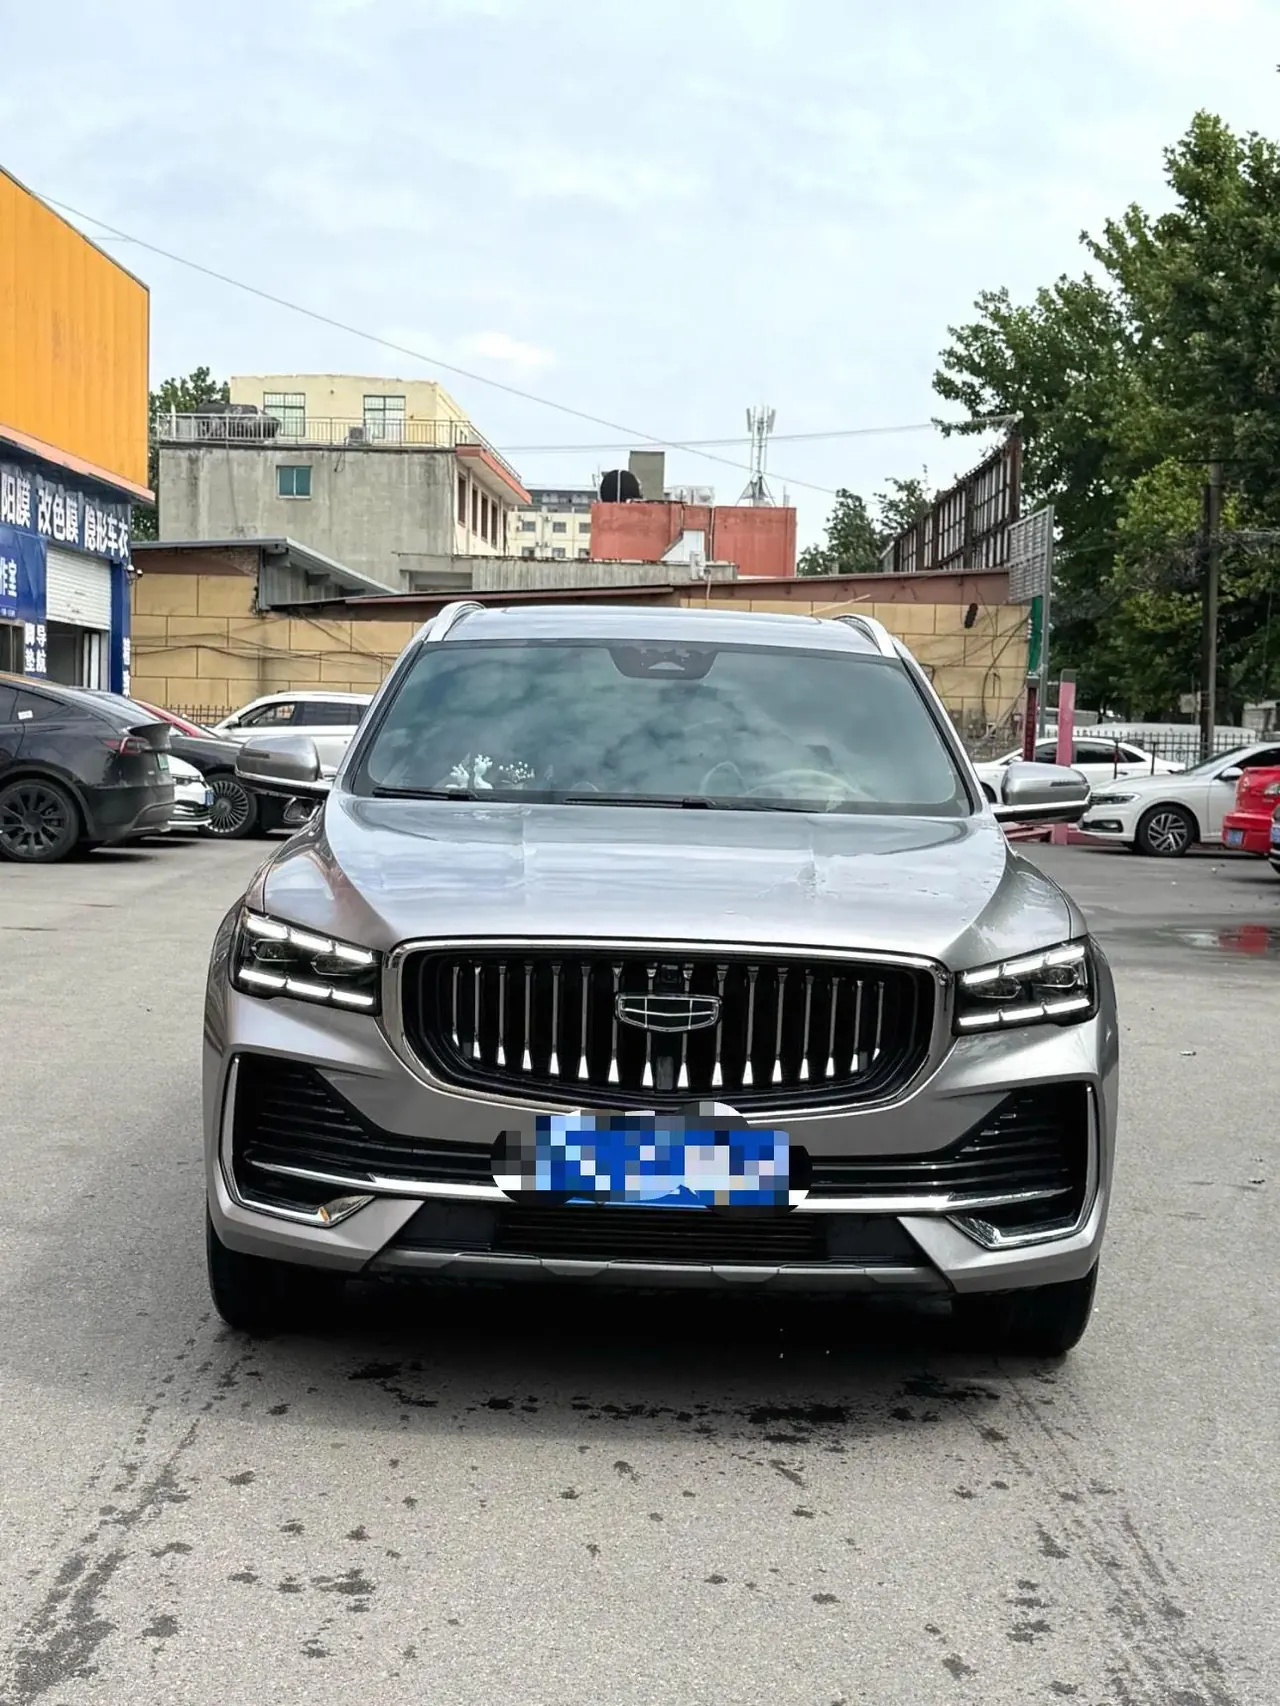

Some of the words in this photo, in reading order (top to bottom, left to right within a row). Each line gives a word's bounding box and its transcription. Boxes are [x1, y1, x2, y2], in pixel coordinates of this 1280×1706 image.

[37, 487, 79, 545] 改色膜
[84, 503, 129, 559] 隐形车衣
